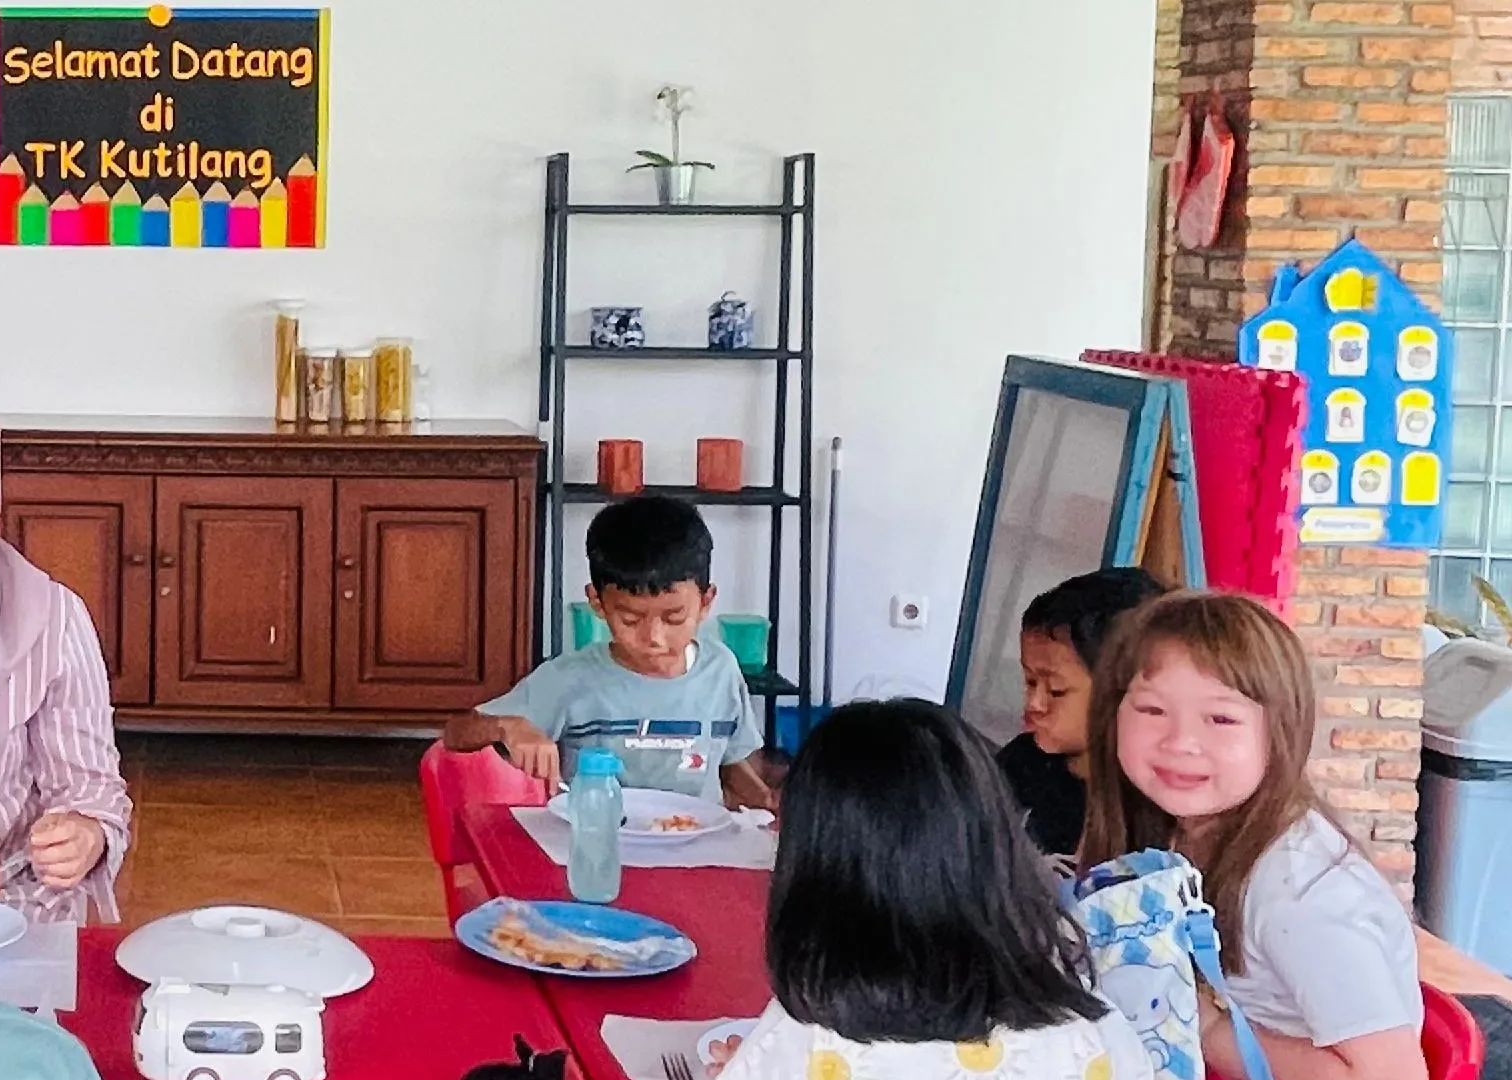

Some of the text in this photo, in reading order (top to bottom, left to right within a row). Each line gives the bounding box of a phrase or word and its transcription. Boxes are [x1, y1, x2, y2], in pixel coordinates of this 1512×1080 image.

[2, 40, 314, 87] Selamat Datang
[140, 92, 175, 132] di
[24, 139, 273, 189] TK Kutilang
